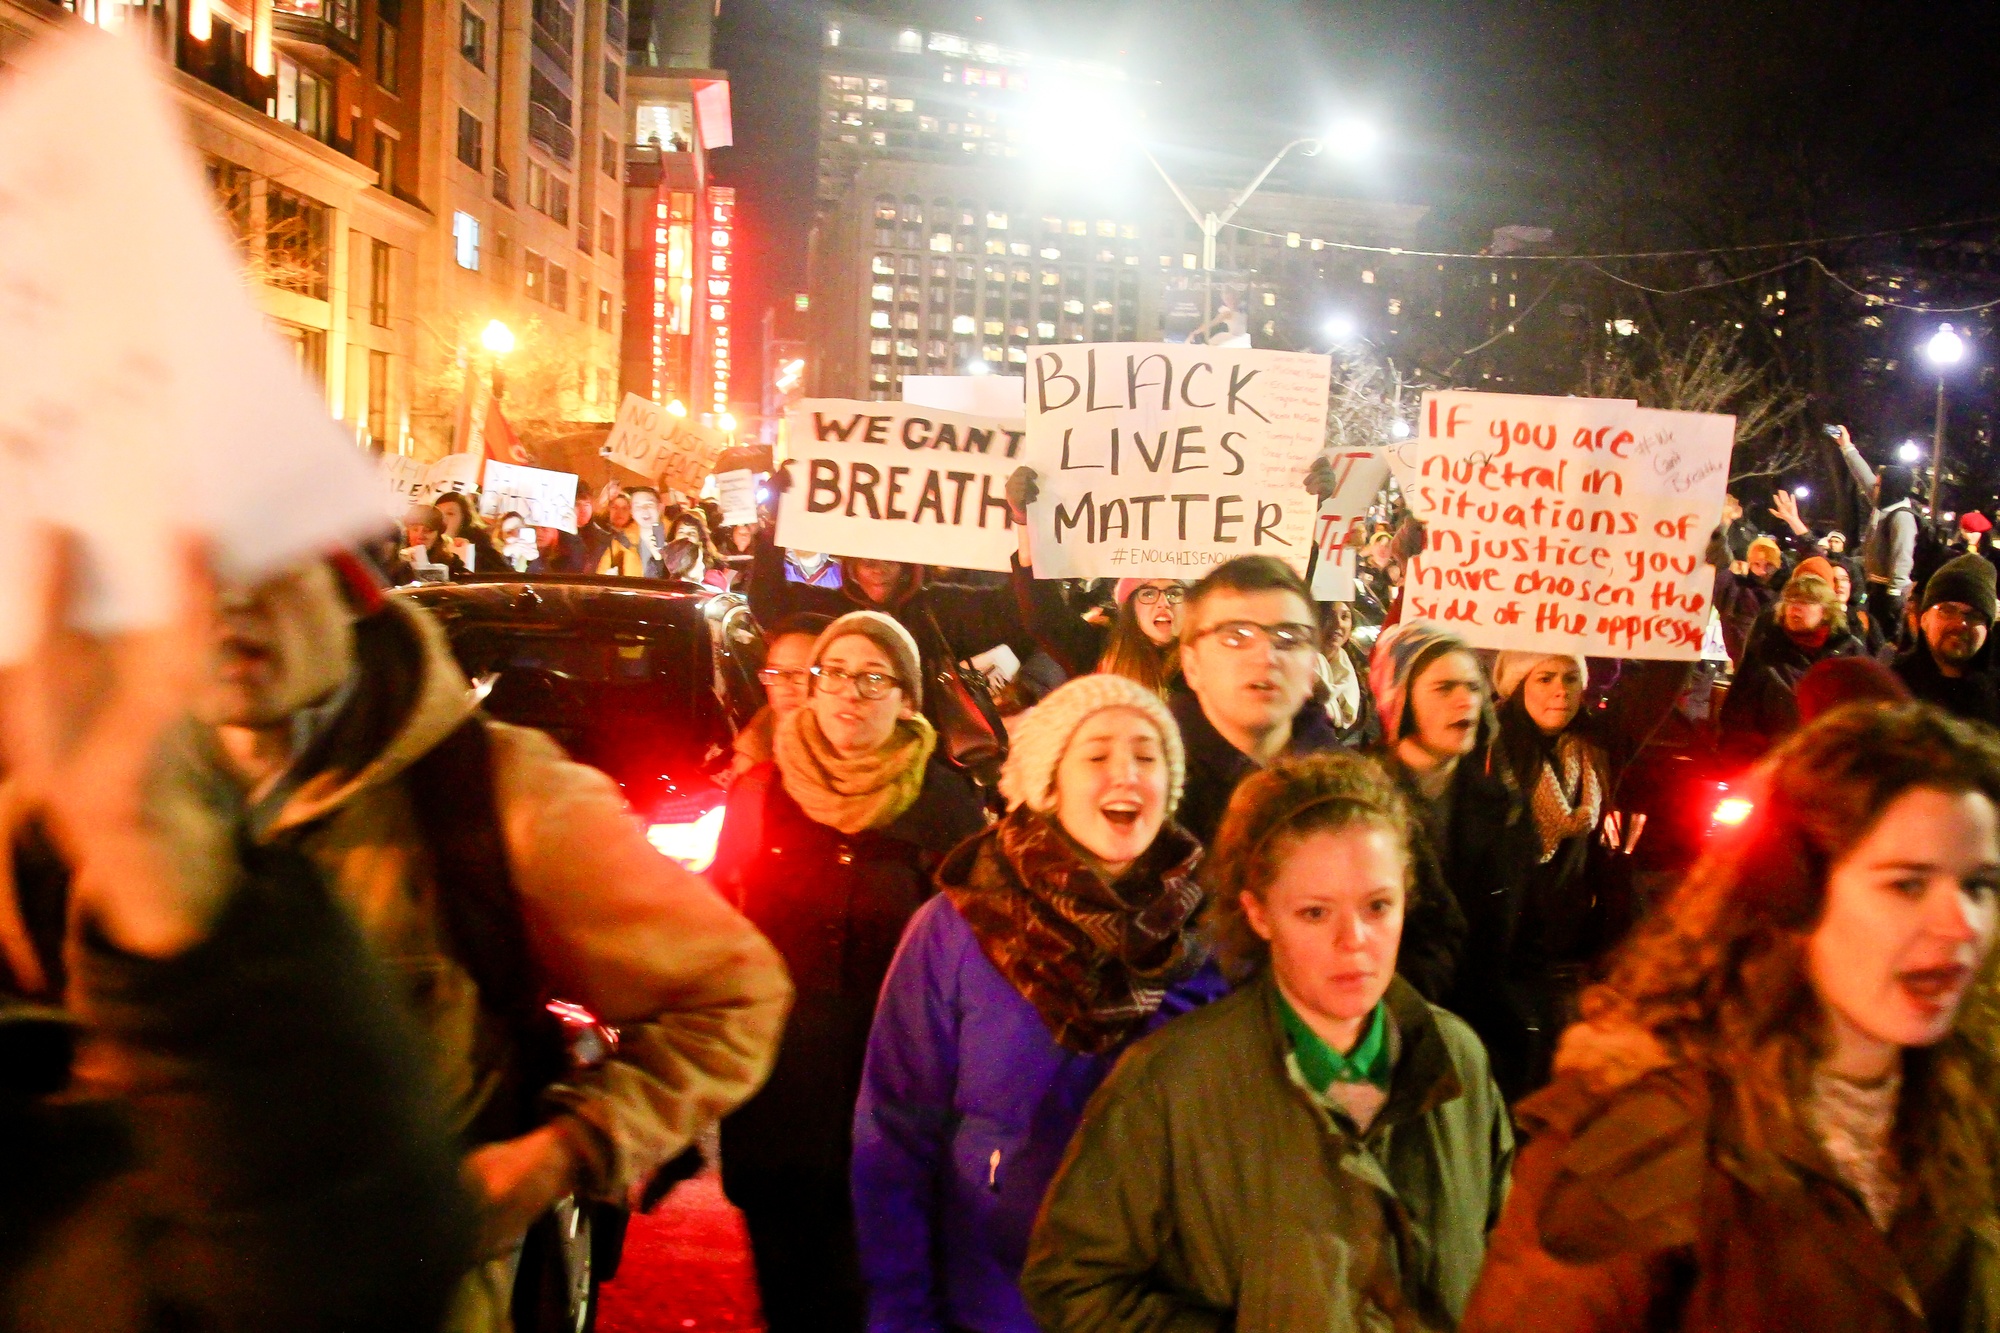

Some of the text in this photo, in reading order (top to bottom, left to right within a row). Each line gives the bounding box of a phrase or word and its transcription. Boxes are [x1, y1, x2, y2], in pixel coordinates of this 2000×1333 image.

[708, 206, 730, 320] LOEWS
[1035, 348, 1272, 424] BLACK
[626, 405, 658, 431] NO
[813, 412, 893, 445] WE
[1429, 399, 1634, 459] If you are
[615, 431, 650, 459] NO
[1060, 425, 1247, 476] LIVES
[388, 478, 466, 498] ILENCE
[807, 458, 1012, 530] BREATH
[1582, 468, 1623, 497] in
[1054, 491, 1293, 547] MATTER
[1420, 486, 1699, 541] situations of
[1412, 555, 1705, 614] have chosen the
[1624, 550, 1696, 583] you
[1411, 597, 1483, 626] side
[1494, 601, 1526, 625] of
[1535, 601, 1587, 637] the
